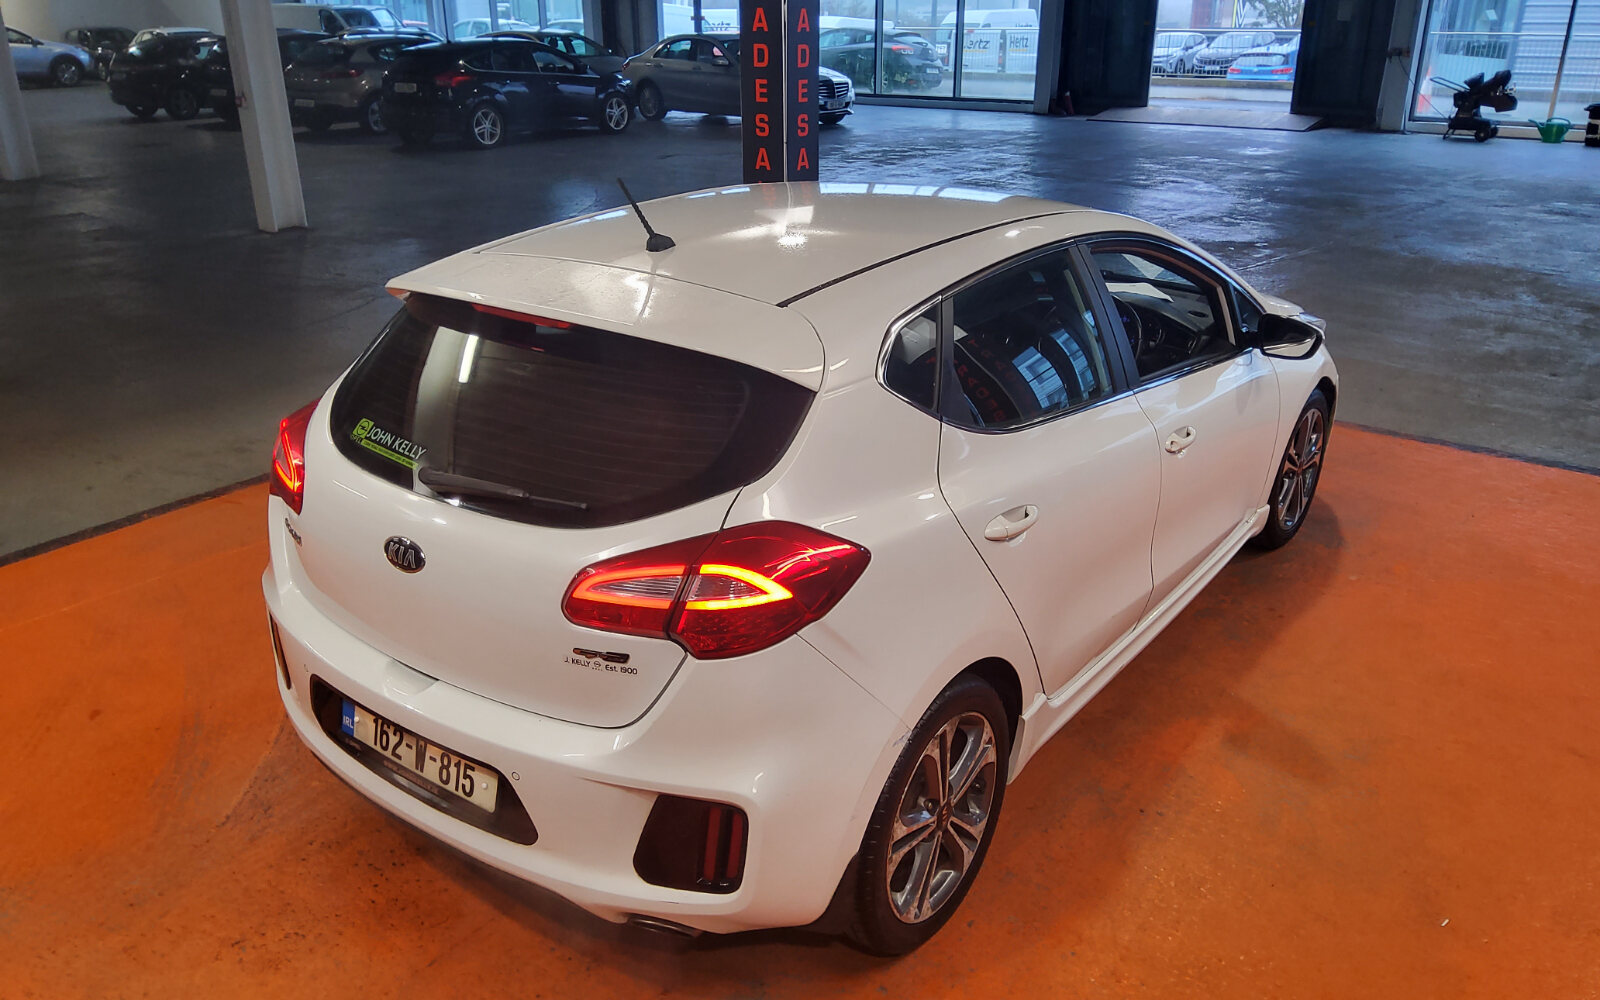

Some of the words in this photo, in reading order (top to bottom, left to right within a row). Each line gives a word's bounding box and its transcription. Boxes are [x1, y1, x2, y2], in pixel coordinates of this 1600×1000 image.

[964, 37, 991, 50] ertz
[1009, 34, 1029, 49] Hertz
[752, 7, 771, 171] ADESA
[797, 8, 810, 171] ADESA
[367, 427, 395, 446] JOHN
[392, 437, 427, 460] KELLY
[388, 541, 416, 569] KIA
[571, 657, 591, 668] KELLY
[343, 715, 354, 729] IRL
[373, 718, 475, 798] 162-W-815
